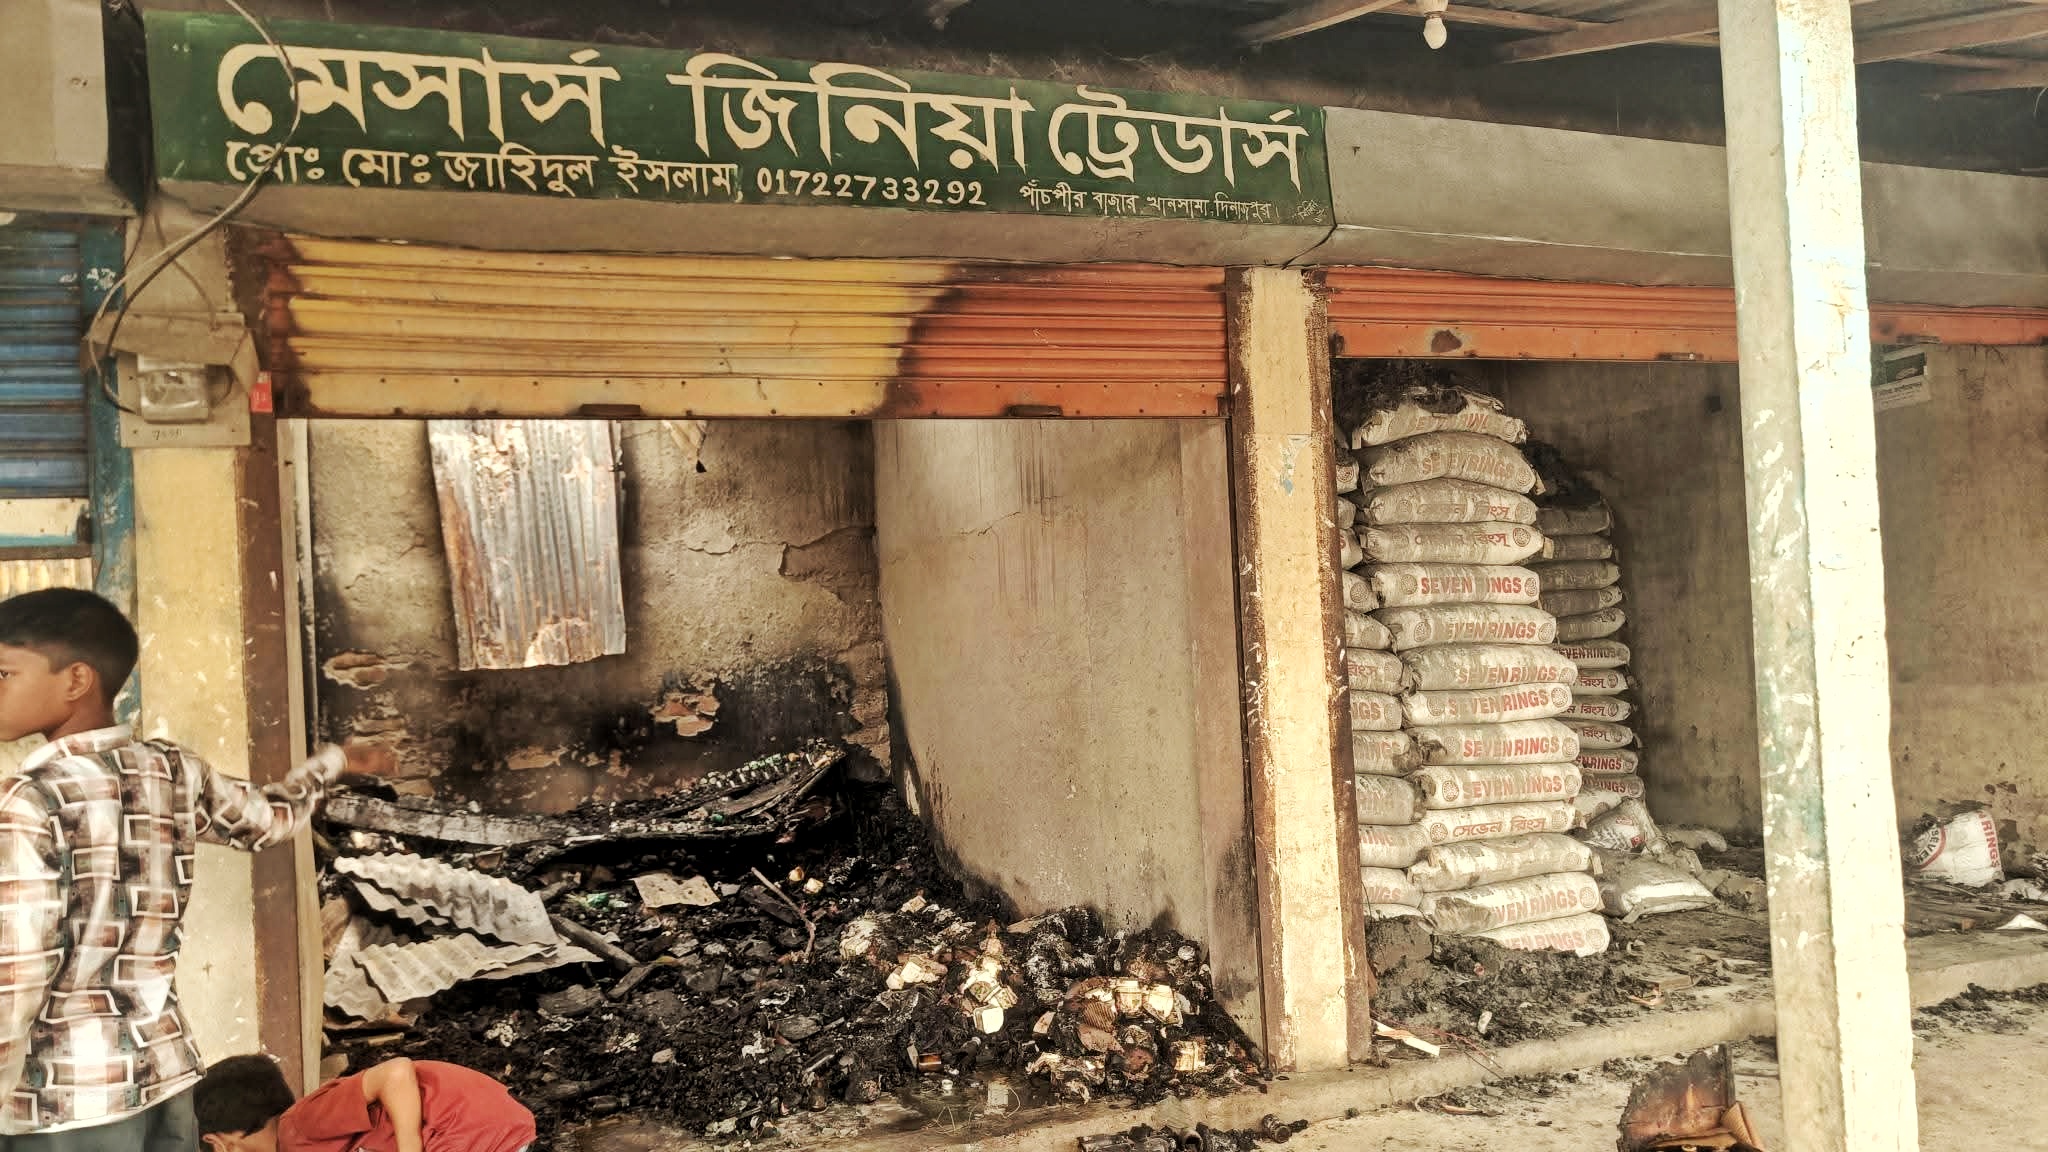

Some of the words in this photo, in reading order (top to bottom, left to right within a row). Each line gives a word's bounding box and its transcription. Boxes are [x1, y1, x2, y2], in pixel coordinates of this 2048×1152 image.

[217, 43, 620, 149] মেসার্স
[666, 53, 1035, 175] জিনিয়া
[1048, 84, 1310, 194] ট্রেডার্স
[342, 148, 432, 188] মোঃ
[437, 142, 600, 197] জাহিদুল
[756, 168, 987, 206] 01722733292
[1019, 179, 1088, 213] পাঁচপীর
[1421, 577, 1473, 594] SEVEN
[1503, 689, 1550, 711] RINGS
[1463, 739, 1513, 758] SEVEN
[1514, 736, 1561, 757] RINGS
[1453, 821, 1503, 838] সেভেন
[1982, 820, 2001, 869] RINGS
